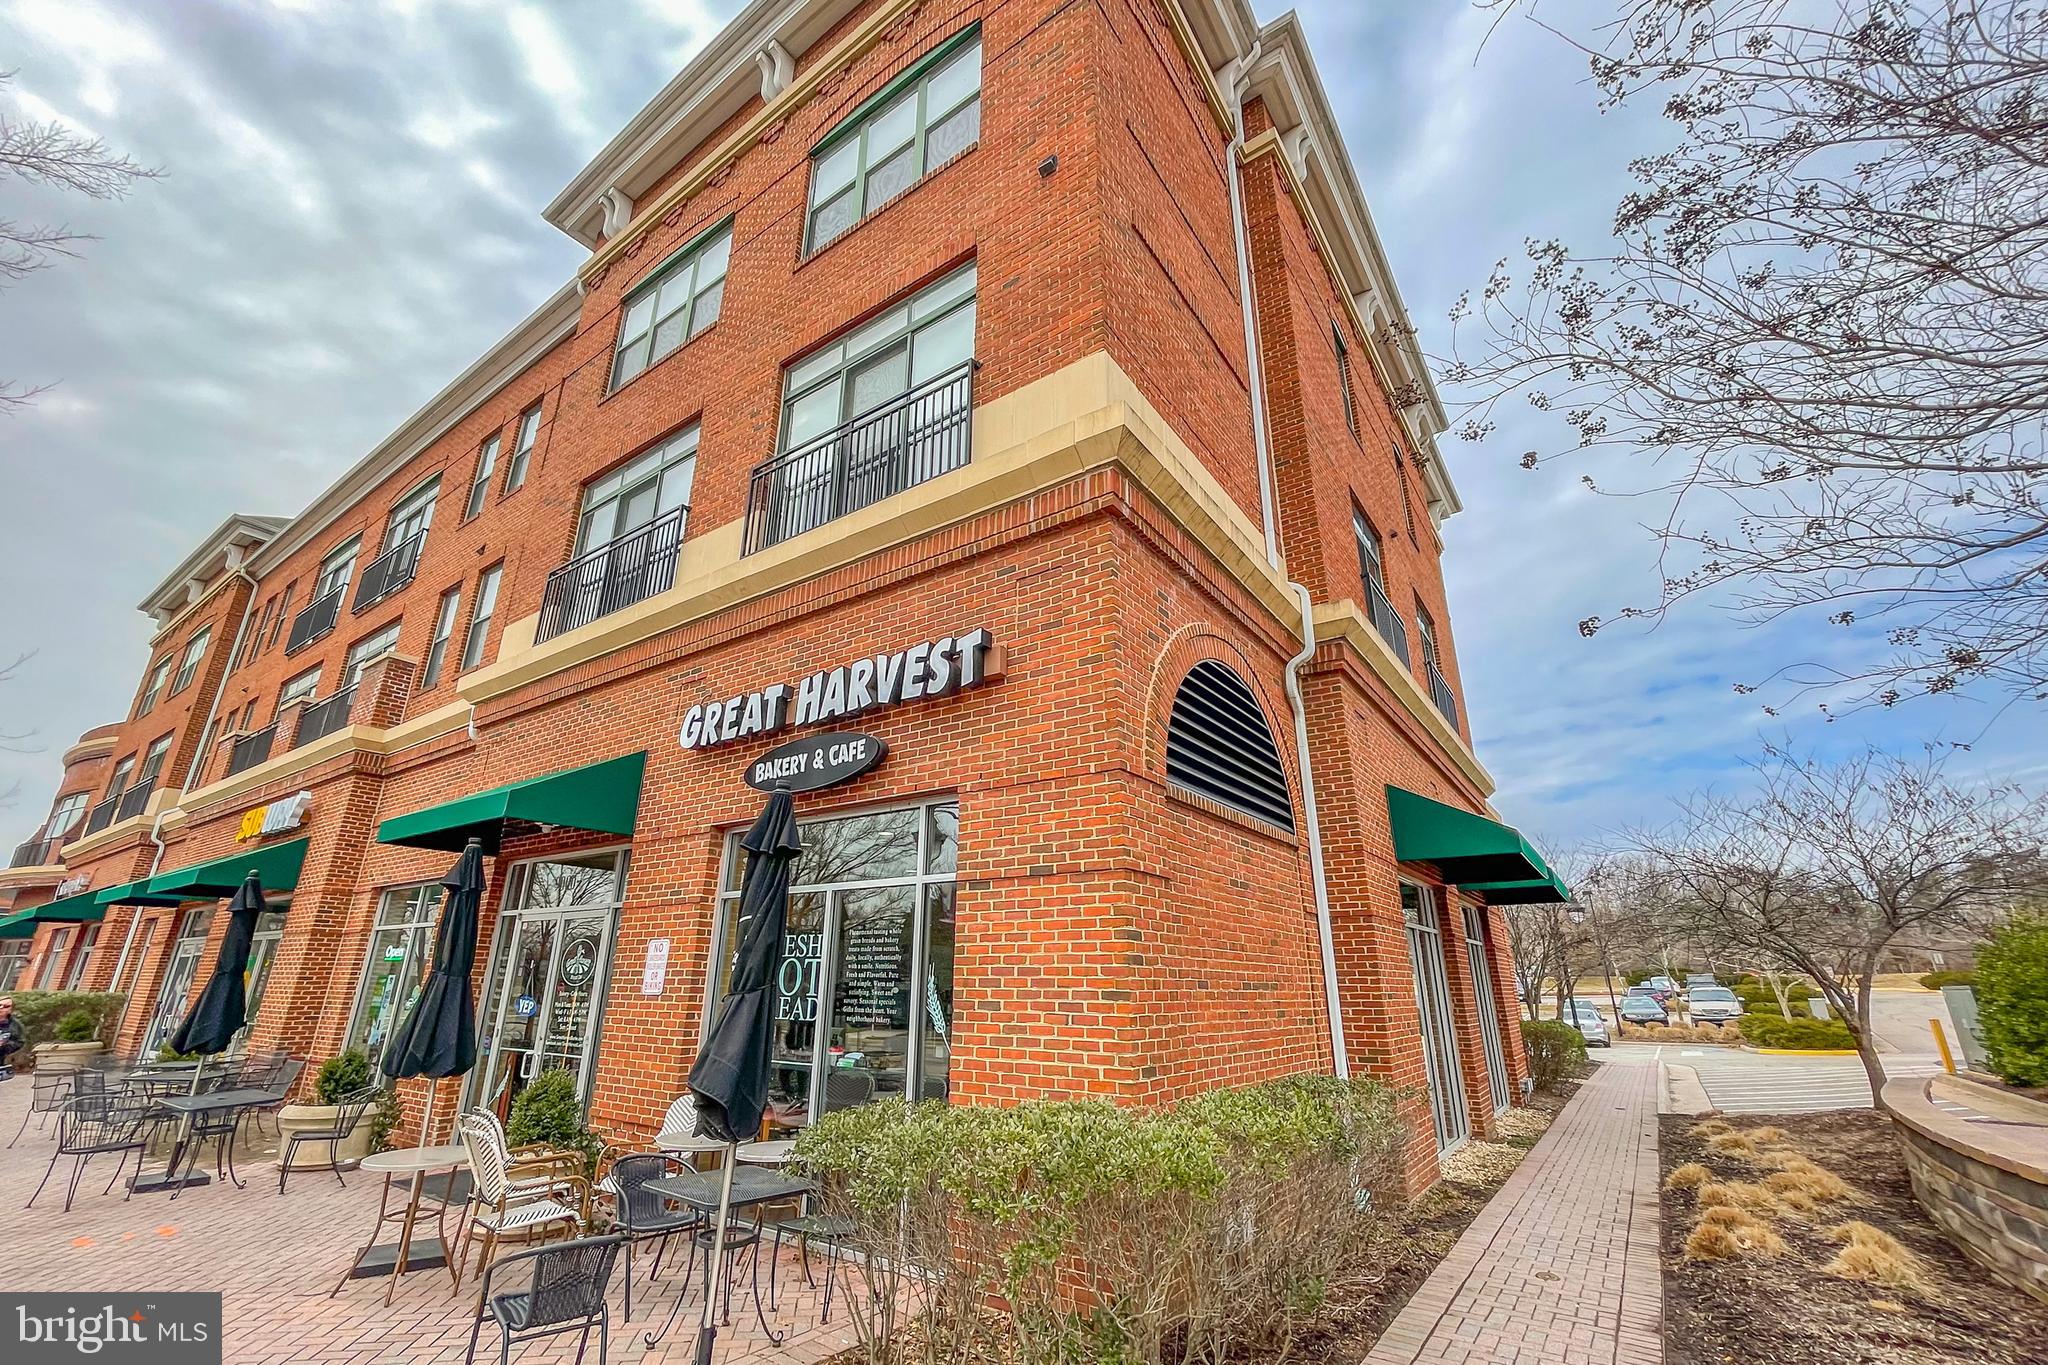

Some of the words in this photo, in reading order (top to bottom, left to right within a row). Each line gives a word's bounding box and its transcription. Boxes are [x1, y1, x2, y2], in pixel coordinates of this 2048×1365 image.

[679, 683, 786, 749] GREAT
[795, 627, 984, 727] HARVEST
[755, 752, 808, 784] BAKERY
[812, 748, 825, 770] &
[828, 738, 867, 767] CAFE
[385, 944, 405, 959] Open
[653, 942, 665, 953] NO
[518, 998, 535, 1014] YEP
